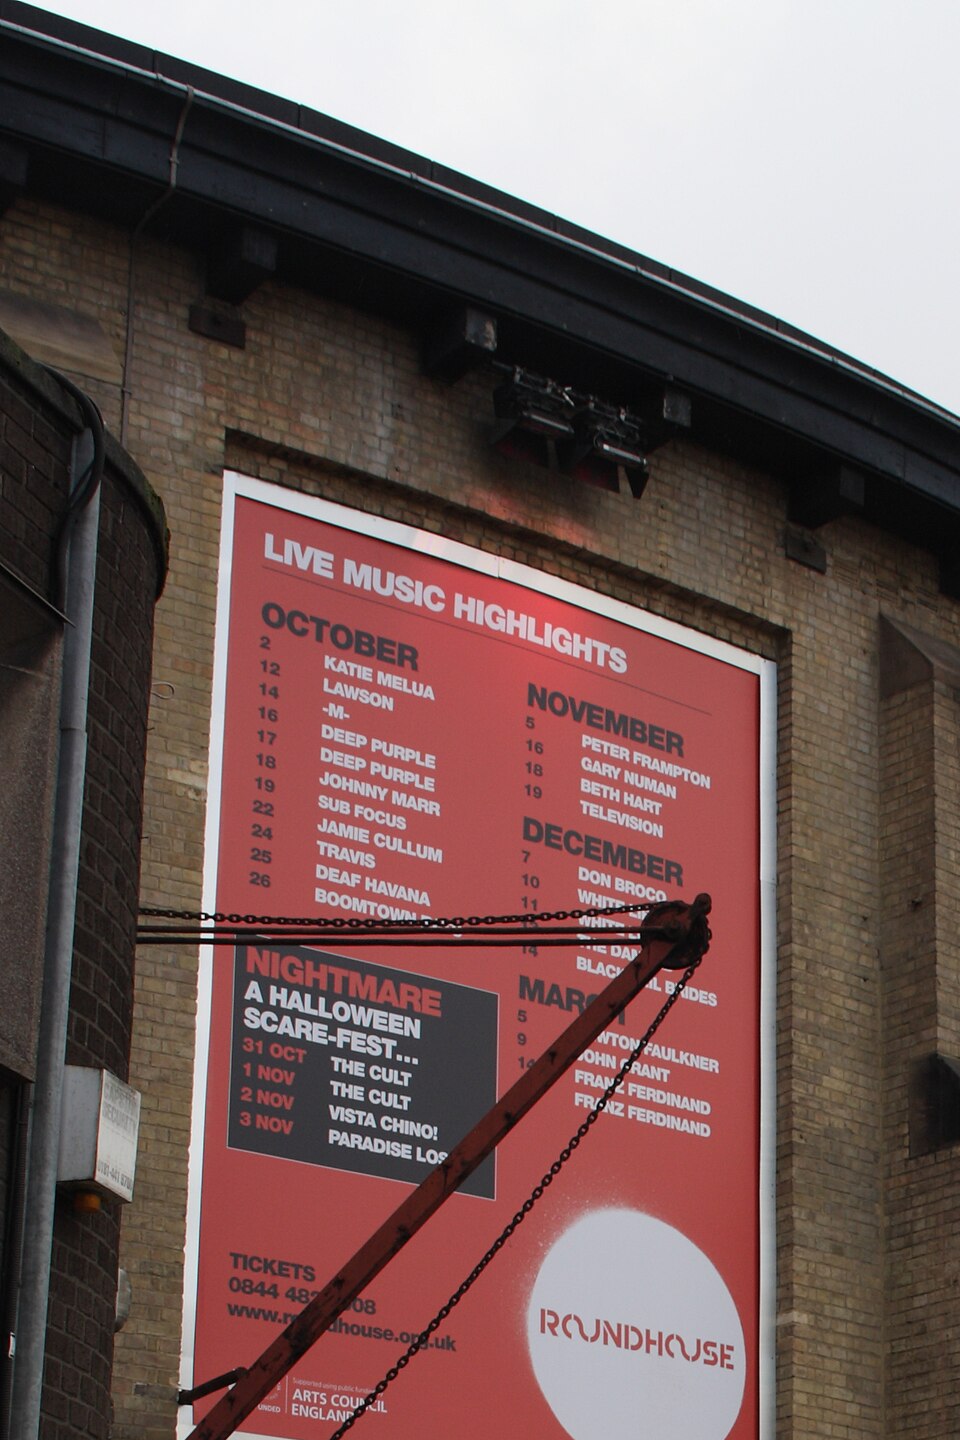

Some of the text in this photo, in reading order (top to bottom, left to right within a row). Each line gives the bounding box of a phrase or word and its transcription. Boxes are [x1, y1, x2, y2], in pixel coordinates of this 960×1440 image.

[264, 533, 628, 674] LIVE MUSIC HIGHLIGHTS
[261, 602, 419, 671] OCTOBER
[259, 636, 435, 701] 2 KATIE MELUA
[260, 660, 394, 712] 12 LAWSON
[259, 683, 350, 721] 14 -M-
[527, 682, 685, 757] NOVEMBER
[257, 730, 435, 792] 17 DEEP PURPLE
[258, 706, 436, 770] 16 DEEP PURPLE
[525, 716, 711, 789] 5 PETER FRAMPTON
[256, 753, 440, 817] 18 JOHNNY MARR
[525, 761, 662, 815] 18 BETH HART
[526, 739, 676, 799] 16 GARY NUMAN
[254, 777, 407, 830] 19 SUB FOCUS
[524, 783, 663, 838] 19 TELEVISION
[251, 824, 376, 870] 24 TRAVIS
[252, 800, 443, 864] 22 JAMIE CULLUM
[522, 816, 684, 887] DECEMBER
[249, 871, 417, 921] 26 BOOMTOWN
[250, 847, 430, 907] 25 DEAF HAVANA
[521, 873, 540, 889] 10
[522, 850, 667, 902] 7 DON BROCO
[521, 896, 538, 911] 11
[246, 946, 442, 1018] NIGHTMARE
[518, 974, 625, 1026] MAR
[244, 980, 421, 1039] A HALLOWEEN
[242, 1037, 412, 1087] 31 OCT THE CULT
[517, 1033, 526, 1046] 9
[518, 1010, 719, 1073] 5 WTON FAULKNER
[243, 1063, 411, 1111] 1 NOV THE CULT
[575, 1069, 624, 1094] FRANZ
[628, 1082, 711, 1115] FERDINAND
[240, 1087, 438, 1141] 2 NOV VISTA CHINO!
[240, 1112, 449, 1165] 3 NOV PARADISE LOS
[574, 1092, 711, 1137] FRANZ FERDINAND
[229, 1277, 278, 1299] 0844
[230, 1252, 316, 1282] TICKETS
[227, 1303, 456, 1352] www.rdhouse.or.uk
[540, 1308, 734, 1370] ROUNDHOUSE
[258, 1404, 281, 1413] UNDED
[292, 1404, 354, 1423] ENGLAND
[293, 1388, 327, 1404] ARTS
